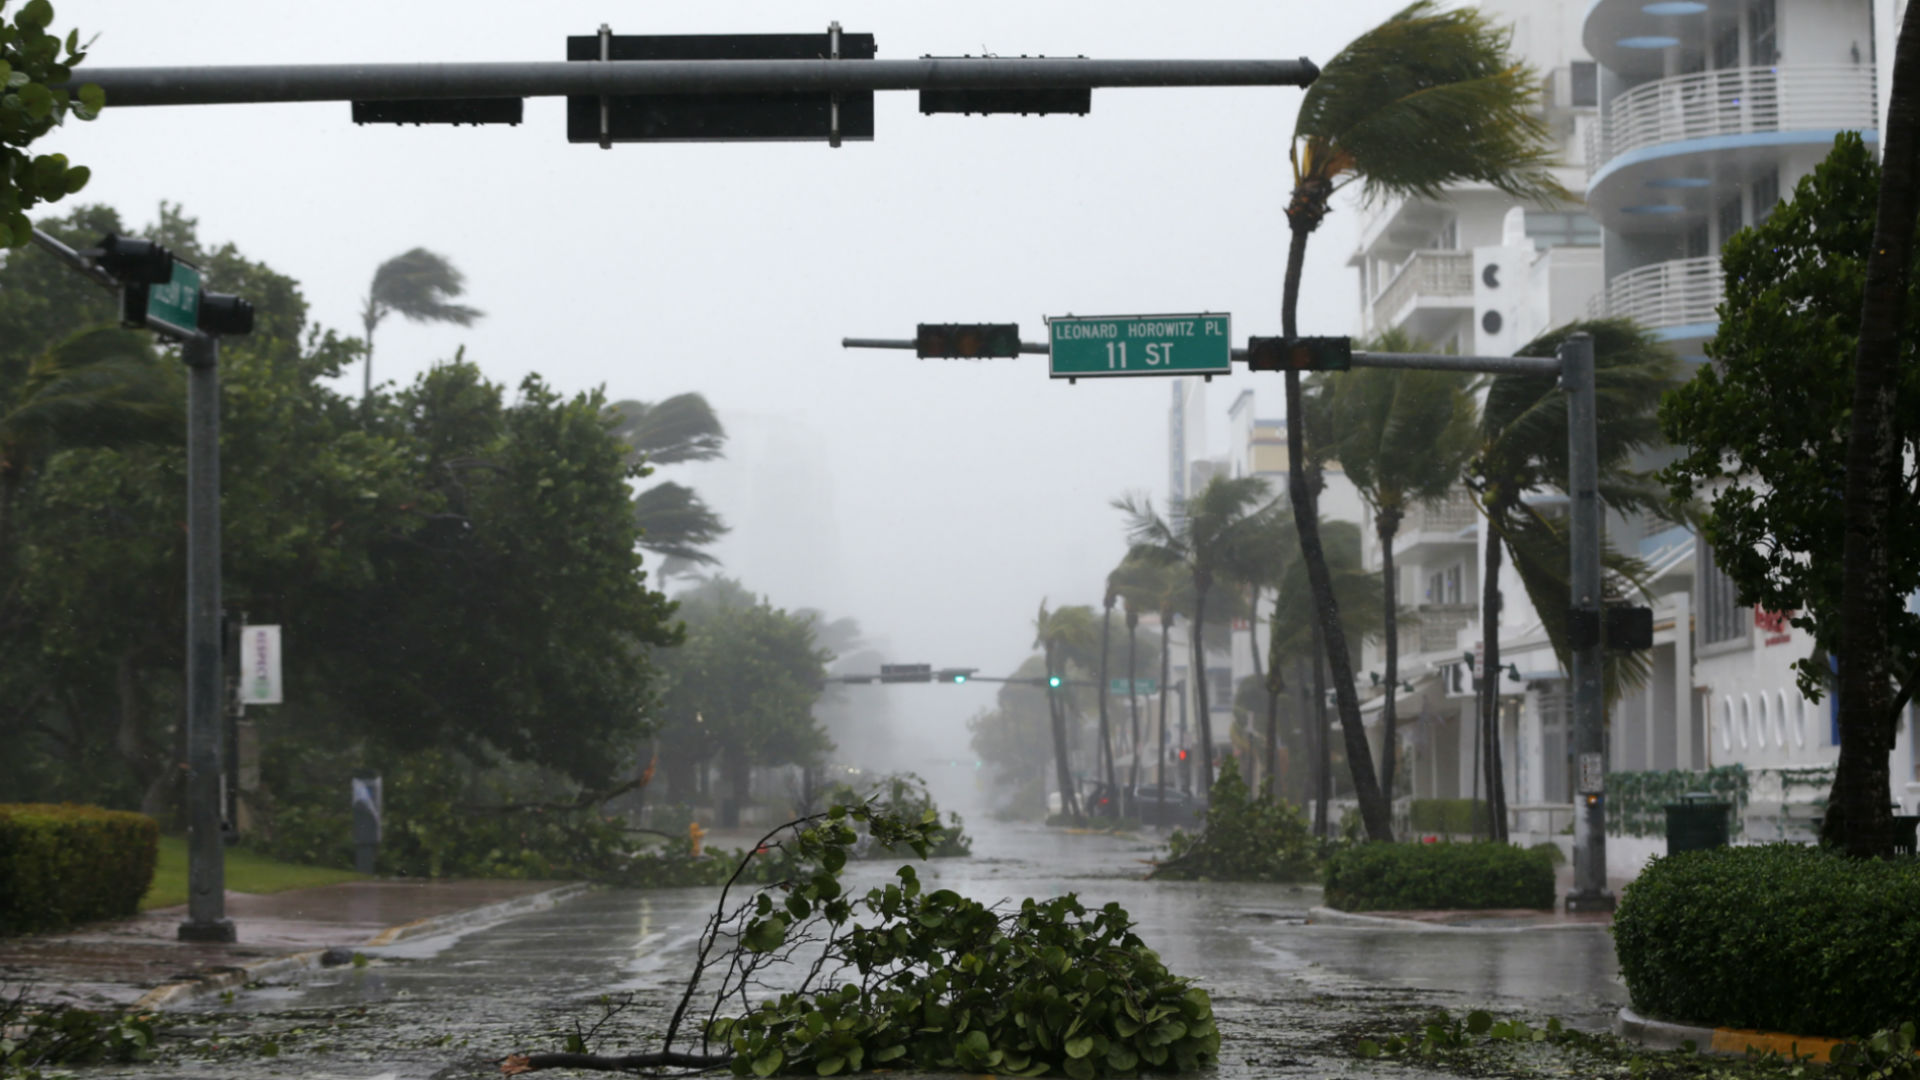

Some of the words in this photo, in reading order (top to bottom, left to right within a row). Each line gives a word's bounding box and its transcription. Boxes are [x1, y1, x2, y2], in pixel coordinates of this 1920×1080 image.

[1056, 323, 1118, 339] LEONARD
[1128, 321, 1195, 338] HOROWITZ
[1205, 320, 1223, 336] PL
[1106, 341, 1127, 369] 11
[1145, 342, 1174, 366] ST
